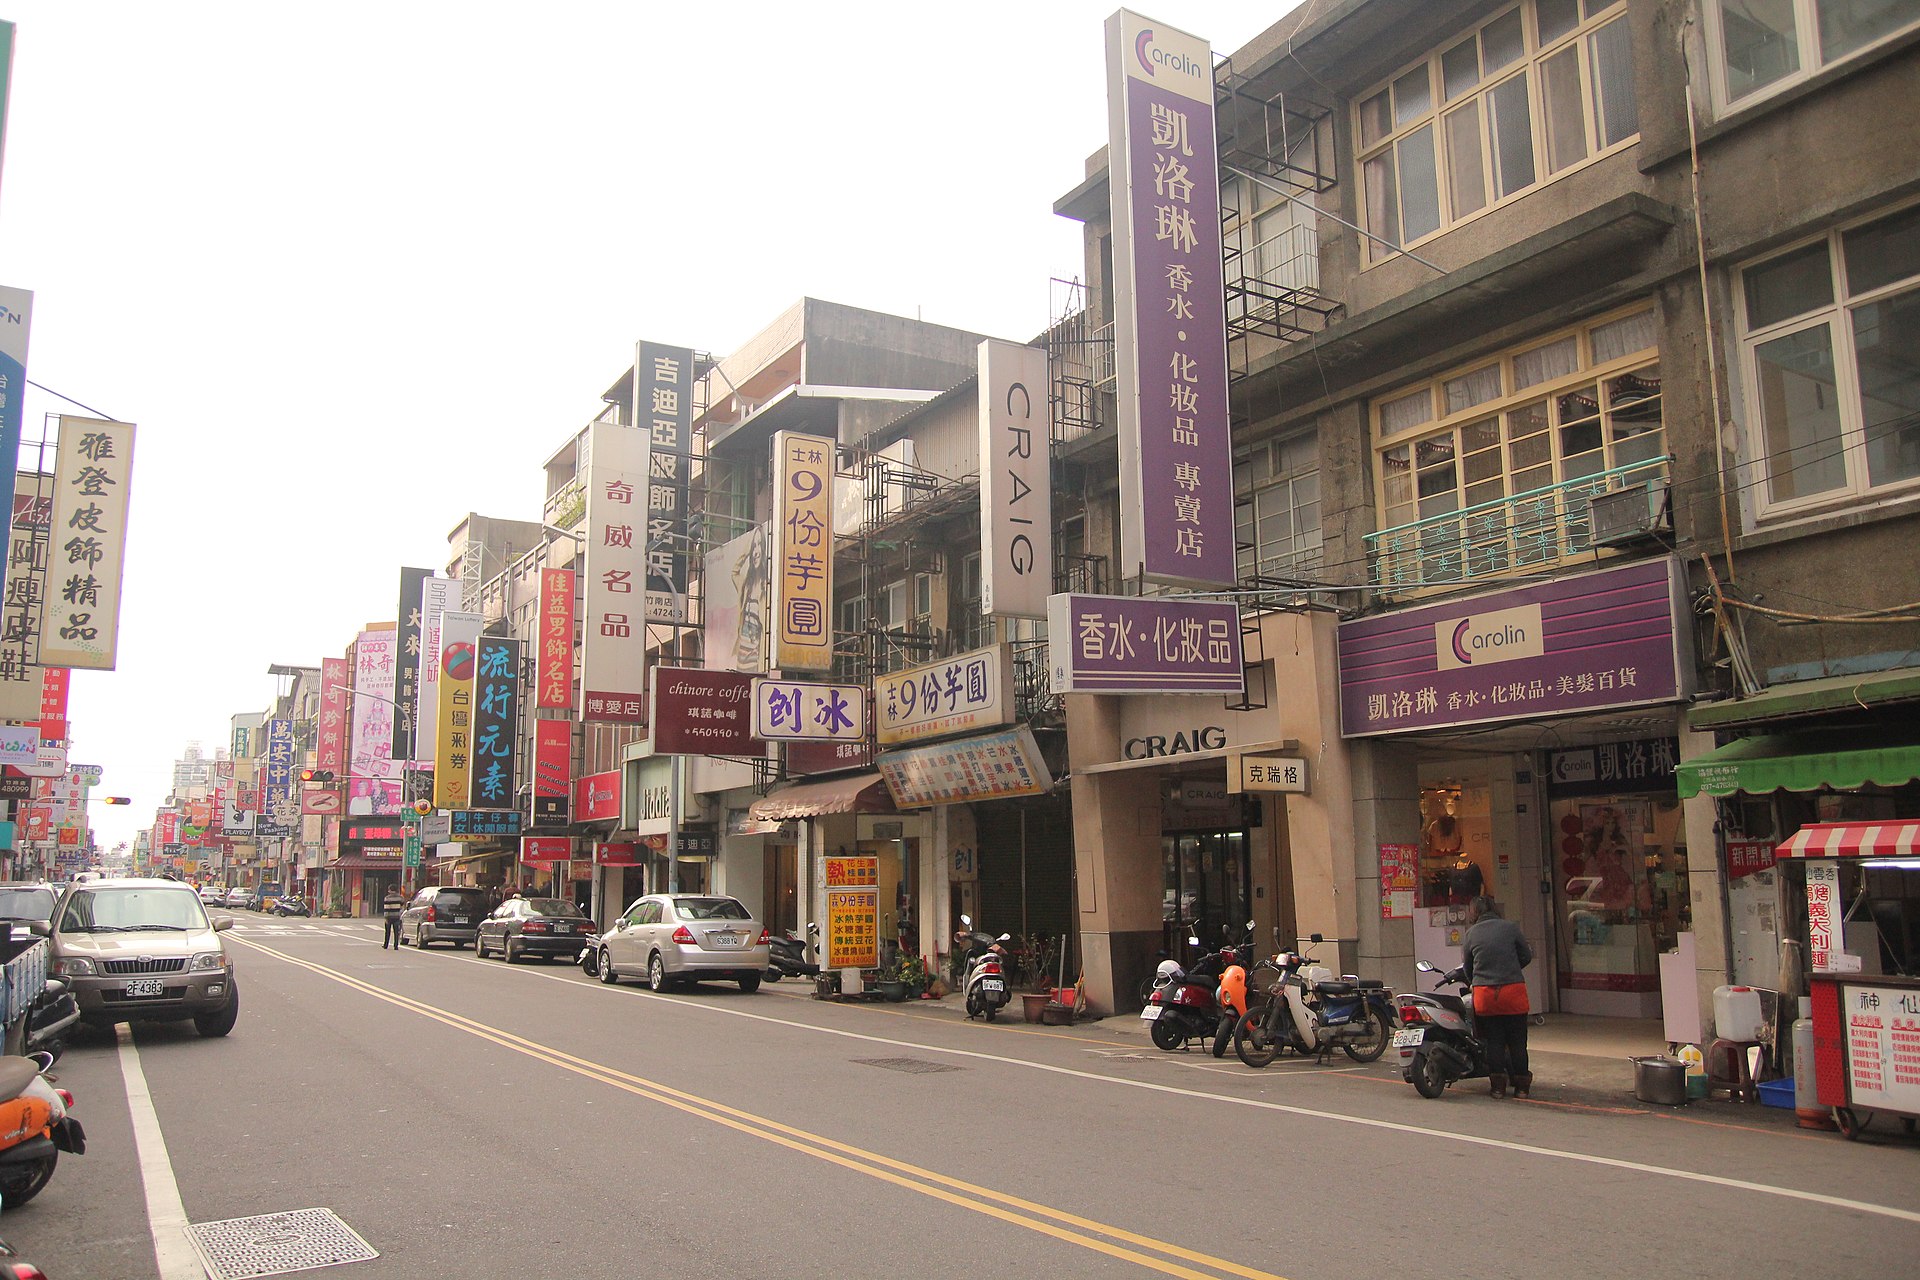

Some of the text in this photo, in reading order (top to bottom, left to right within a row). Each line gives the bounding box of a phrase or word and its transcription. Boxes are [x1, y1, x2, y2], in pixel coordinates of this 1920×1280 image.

[1135, 29, 1201, 78] Carolin
[1150, 102, 1199, 254] 凱洛琳
[792, 448, 822, 465] 士林
[1006, 382, 1034, 576] CRAIG
[1173, 461, 1204, 558] 專賣店
[60, 433, 116, 640] 雅登皮飾精品
[601, 480, 634, 638] 奇威名品
[787, 470, 824, 637] 9份芋圓
[543, 573, 568, 704] 佳益男飾名店
[1079, 613, 1231, 664] 香水·化妝品
[1452, 618, 1525, 664] Carolin
[587, 698, 640, 716] 博愛店
[669, 681, 714, 697] chinore
[899, 660, 988, 720] 9份芋圓
[1368, 686, 1439, 721] 凱洛琳
[450, 688, 469, 769] 台灣彩券
[478, 646, 516, 800] 流行元素
[688, 707, 737, 720] 琪諾咖啡
[1124, 726, 1227, 760] CRAIG
[1600, 738, 1675, 780] 凱洛琳
[1249, 765, 1298, 784] 克瑞格
[1555, 756, 1592, 780] Carolin
[828, 861, 846, 885] 熱
[127, 983, 163, 995] 2F-4383
